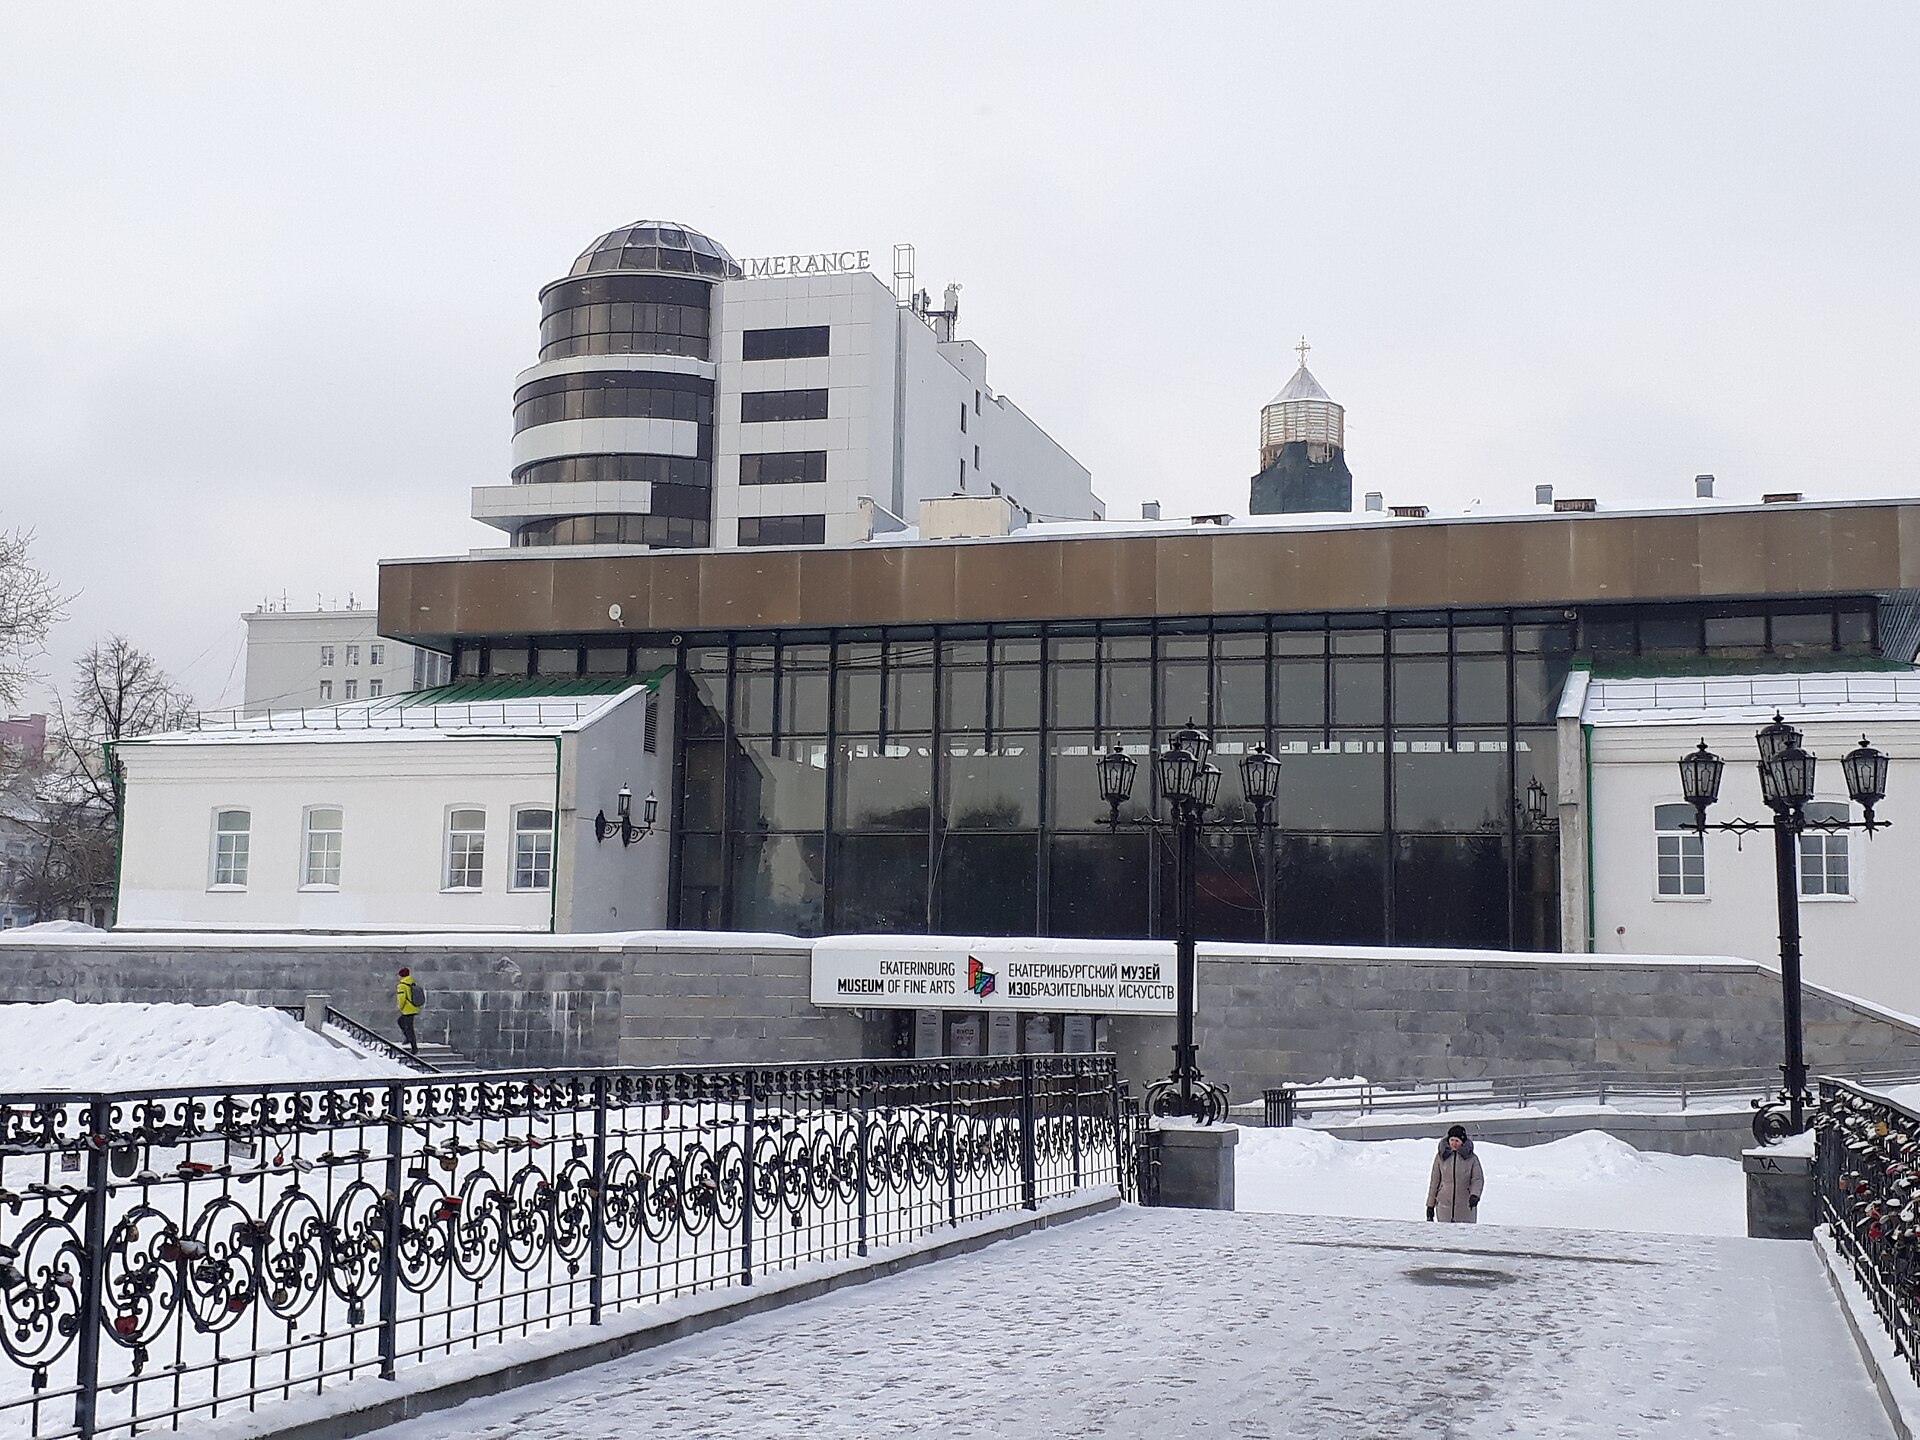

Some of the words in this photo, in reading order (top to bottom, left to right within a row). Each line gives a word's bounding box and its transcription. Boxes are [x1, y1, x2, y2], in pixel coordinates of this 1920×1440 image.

[880, 961, 955, 976] EKATERINBURG
[1008, 963, 1118, 979] ЕКАТЕРИНБУРГСКИЙ
[1121, 964, 1160, 982] МУЗЕЙ
[838, 978, 884, 995] MUSEUM
[888, 980, 900, 993] OF
[904, 980, 927, 994] FINE
[929, 980, 955, 995] ARTS
[1008, 982, 1115, 998] ИЗОБРАЗИТЕЛЬНЫХ
[1119, 984, 1175, 1000] ИСКУССТВ
